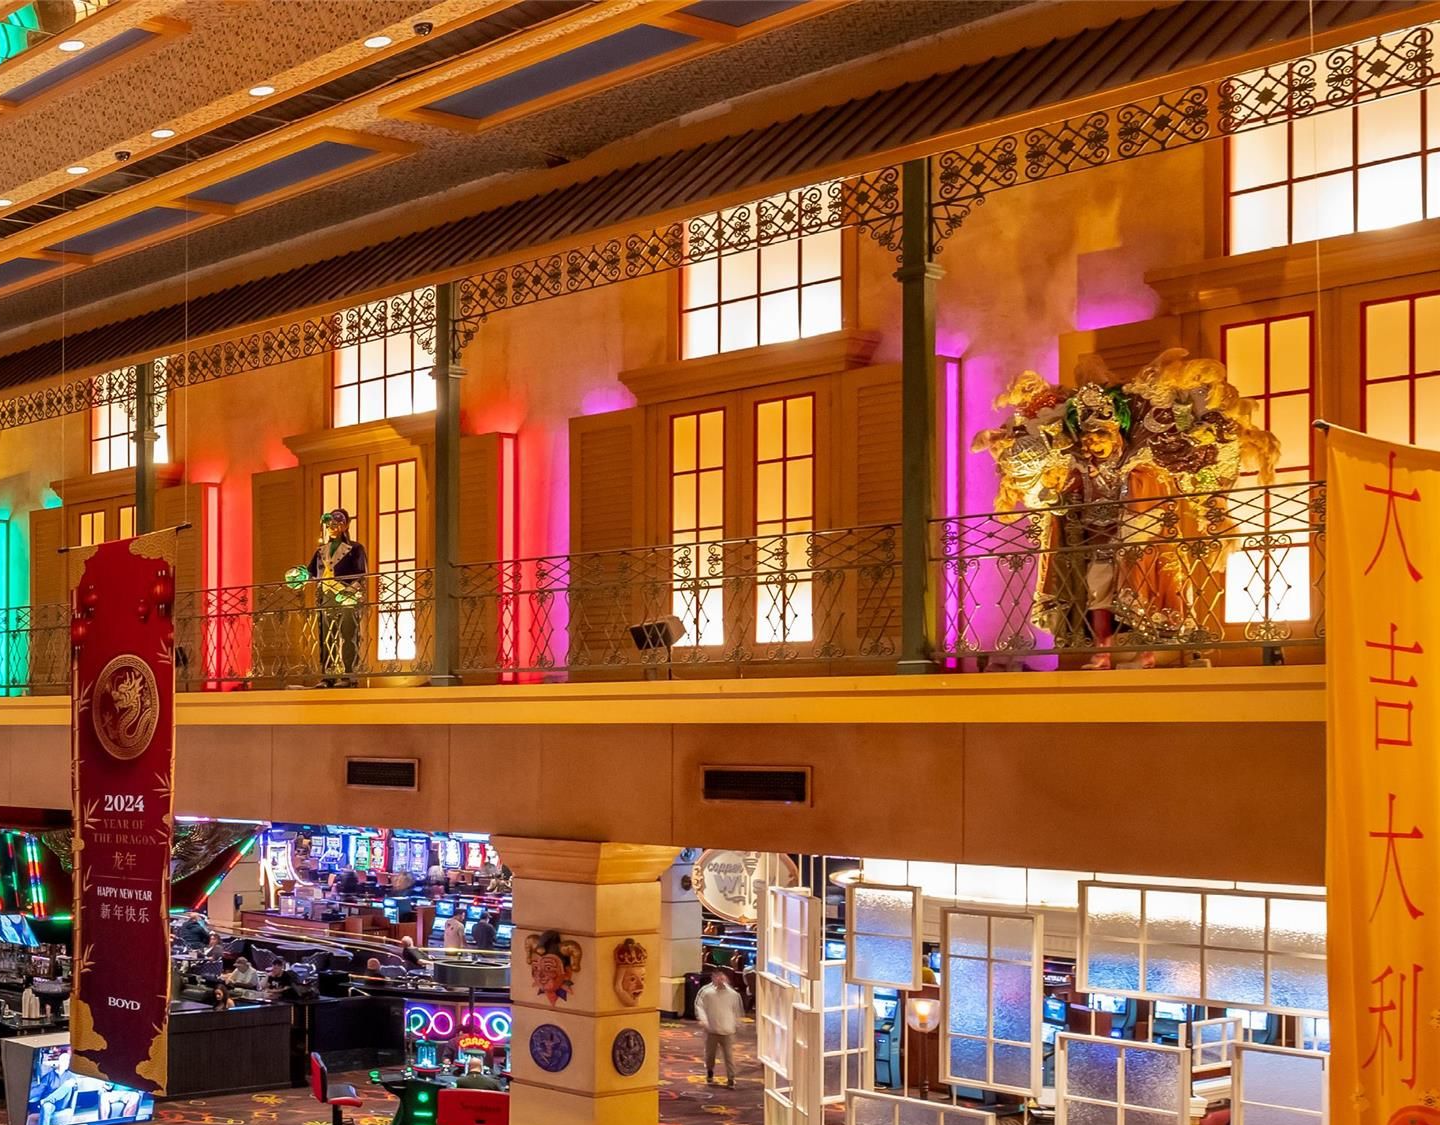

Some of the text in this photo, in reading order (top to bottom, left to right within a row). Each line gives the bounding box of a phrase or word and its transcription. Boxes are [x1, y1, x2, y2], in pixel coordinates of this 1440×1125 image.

[1361, 450, 1426, 1092] 大吉大利
[104, 794, 145, 812] 2024
[103, 818, 145, 830] YEAR OF
[92, 832, 157, 846] THE DRAGON
[112, 851, 137, 871] 龙年
[97, 885, 153, 901] HAPPY NEW YEAR
[100, 902, 150, 924] 新年快乐
[108, 996, 141, 1012] BOYD
[459, 1036, 491, 1049] CRAPS
